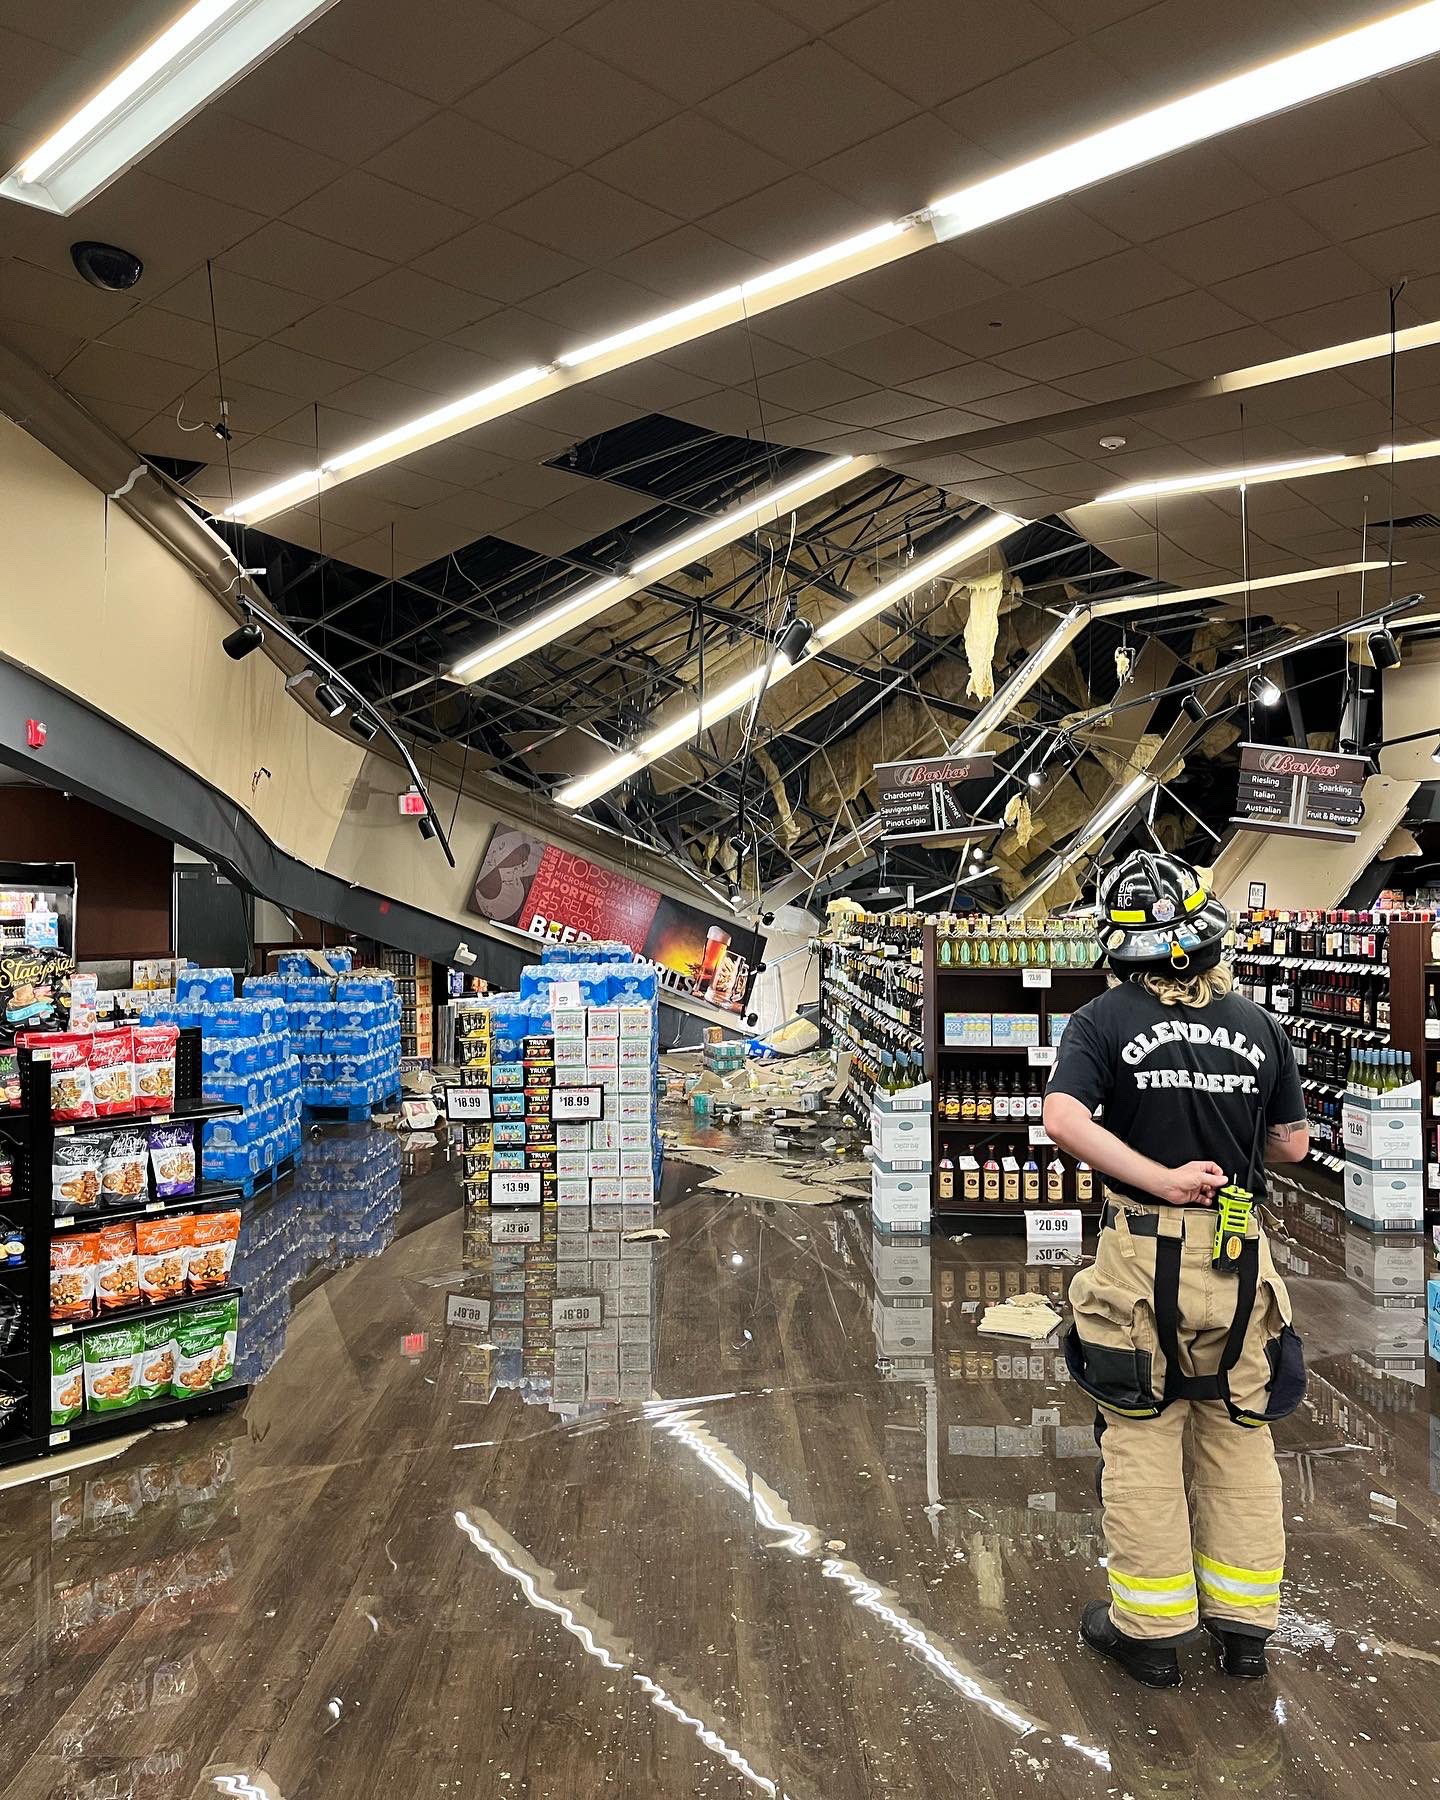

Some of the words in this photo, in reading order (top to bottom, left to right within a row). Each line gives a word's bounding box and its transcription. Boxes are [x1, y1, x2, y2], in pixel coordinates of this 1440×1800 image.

[1251, 776, 1280, 787] Riesling
[1318, 783, 1352, 797] Sparkling
[883, 790, 925, 801] Chardonnay
[942, 789, 961, 819] Cabernet
[1253, 790, 1275, 799] Italian
[880, 805, 912, 816] Sauvignon
[913, 803, 929, 811] Blanc
[1245, 803, 1281, 814] Australian
[1307, 810, 1322, 820] Fruit
[1323, 812, 1329, 820] &
[1329, 813, 1359, 824] Beverage
[886, 818, 905, 827] Pinot
[906, 818, 926, 827] Grigio
[537, 846, 554, 883] AMBER
[542, 849, 561, 887] LAGER
[558, 852, 611, 888] HOPS
[550, 879, 604, 909] PORTER
[554, 871, 607, 898] MICROBREWS
[610, 881, 658, 907] MALTING
[545, 892, 561, 921] OUT
[560, 896, 605, 924] RELAX
[570, 915, 600, 934] COLD
[1152, 919, 1208, 943] WEIS
[0, 958, 56, 989] Stacy's
[1121, 1020, 1266, 1069] GLENDALE
[1134, 1069, 1193, 1090] FIRE
[1193, 1072, 1259, 1094] DEPT.
[454, 1097, 481, 1108] $18.99
[560, 1096, 590, 1107] $18.99
[1347, 1121, 1363, 1137] $12.99
[502, 1182, 530, 1192] $13.99
[1035, 1219, 1068, 1231] $20.99
